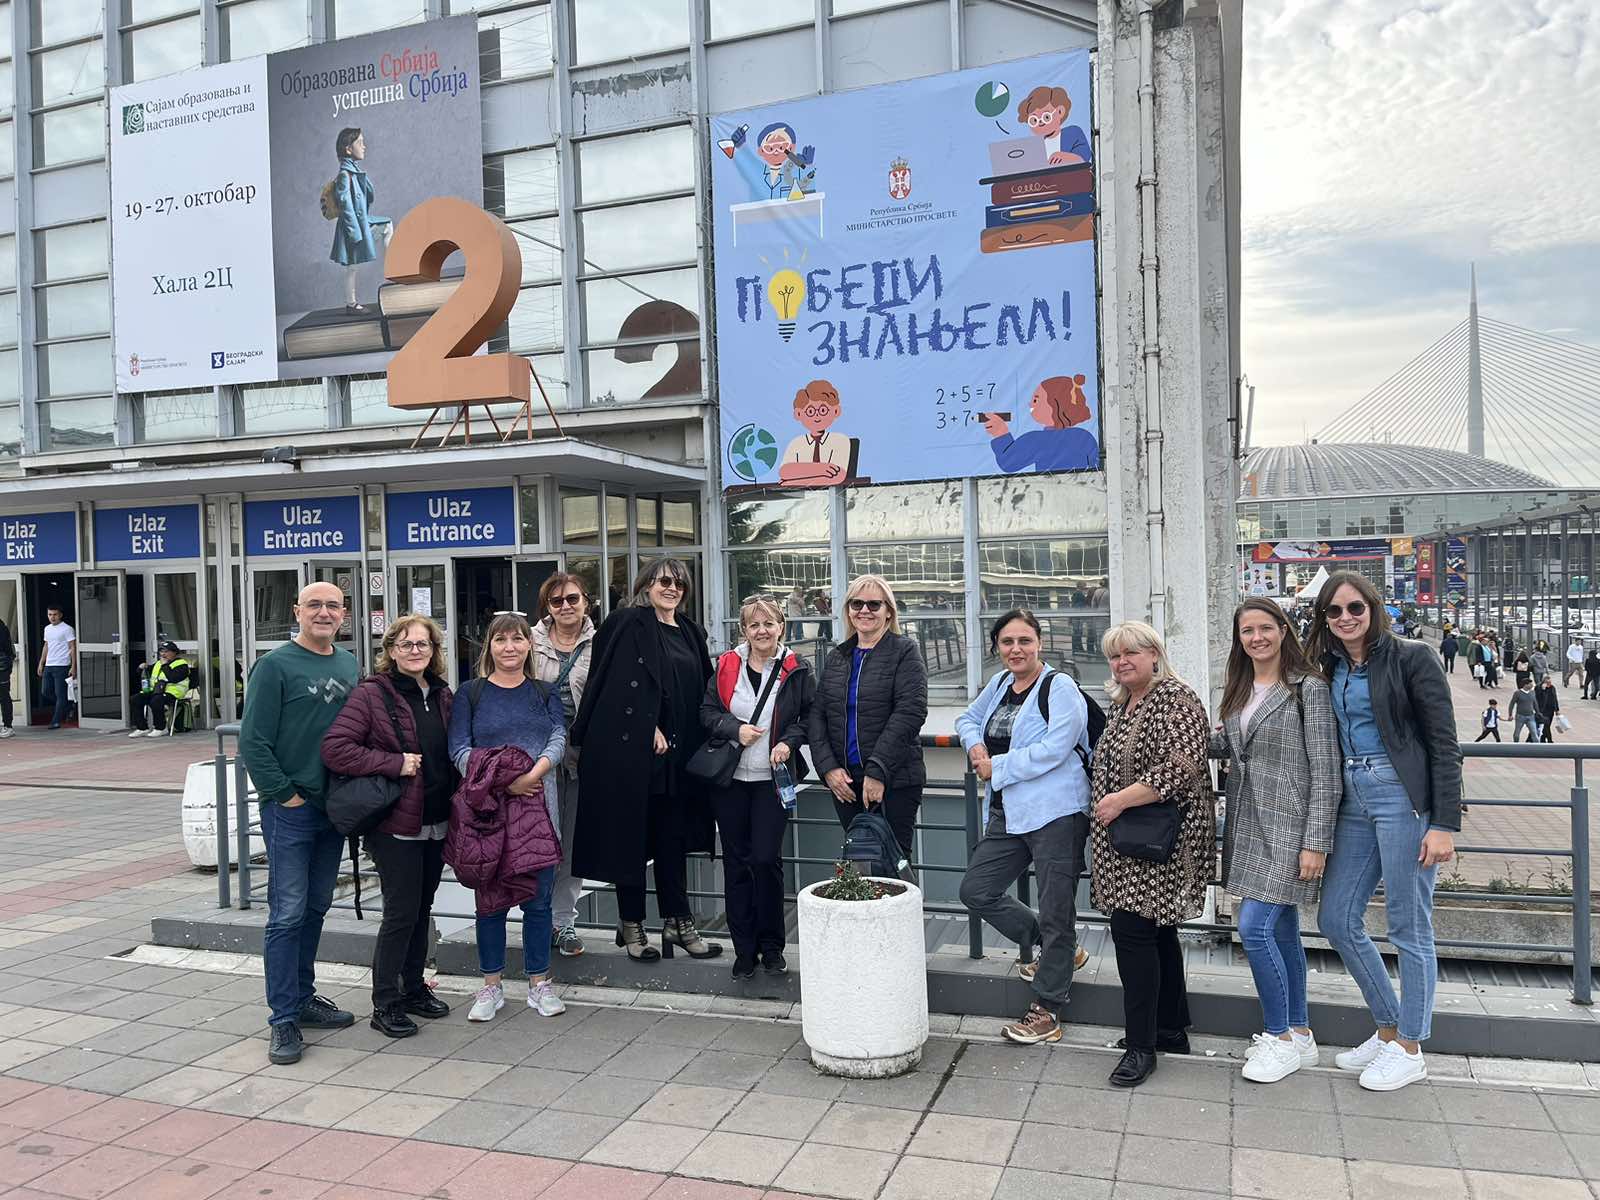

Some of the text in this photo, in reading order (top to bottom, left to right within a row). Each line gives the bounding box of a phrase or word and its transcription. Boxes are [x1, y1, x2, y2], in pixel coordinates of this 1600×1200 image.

[280, 45, 438, 98] Образована Србија
[145, 83, 251, 117] Сајам образовања и
[332, 65, 468, 117] успешна Србија
[146, 102, 256, 132] наставних средстава
[184, 182, 256, 209] октобар
[846, 209, 958, 232] МИНИСТАРСТВО ПРОСВЕТЕ
[152, 266, 233, 296] Хала 2Ц
[384, 197, 531, 410] 2
[808, 290, 1073, 366] ЗНАЊЕМ!
[282, 505, 322, 526] Ulaz
[428, 496, 472, 519] Ulaz
[3, 521, 37, 539] Izlaz
[128, 513, 167, 533] Izlaz
[407, 521, 495, 543] Entrance
[132, 534, 164, 554] Exit
[263, 528, 344, 549] Entrance
[6, 541, 35, 560] Exit
